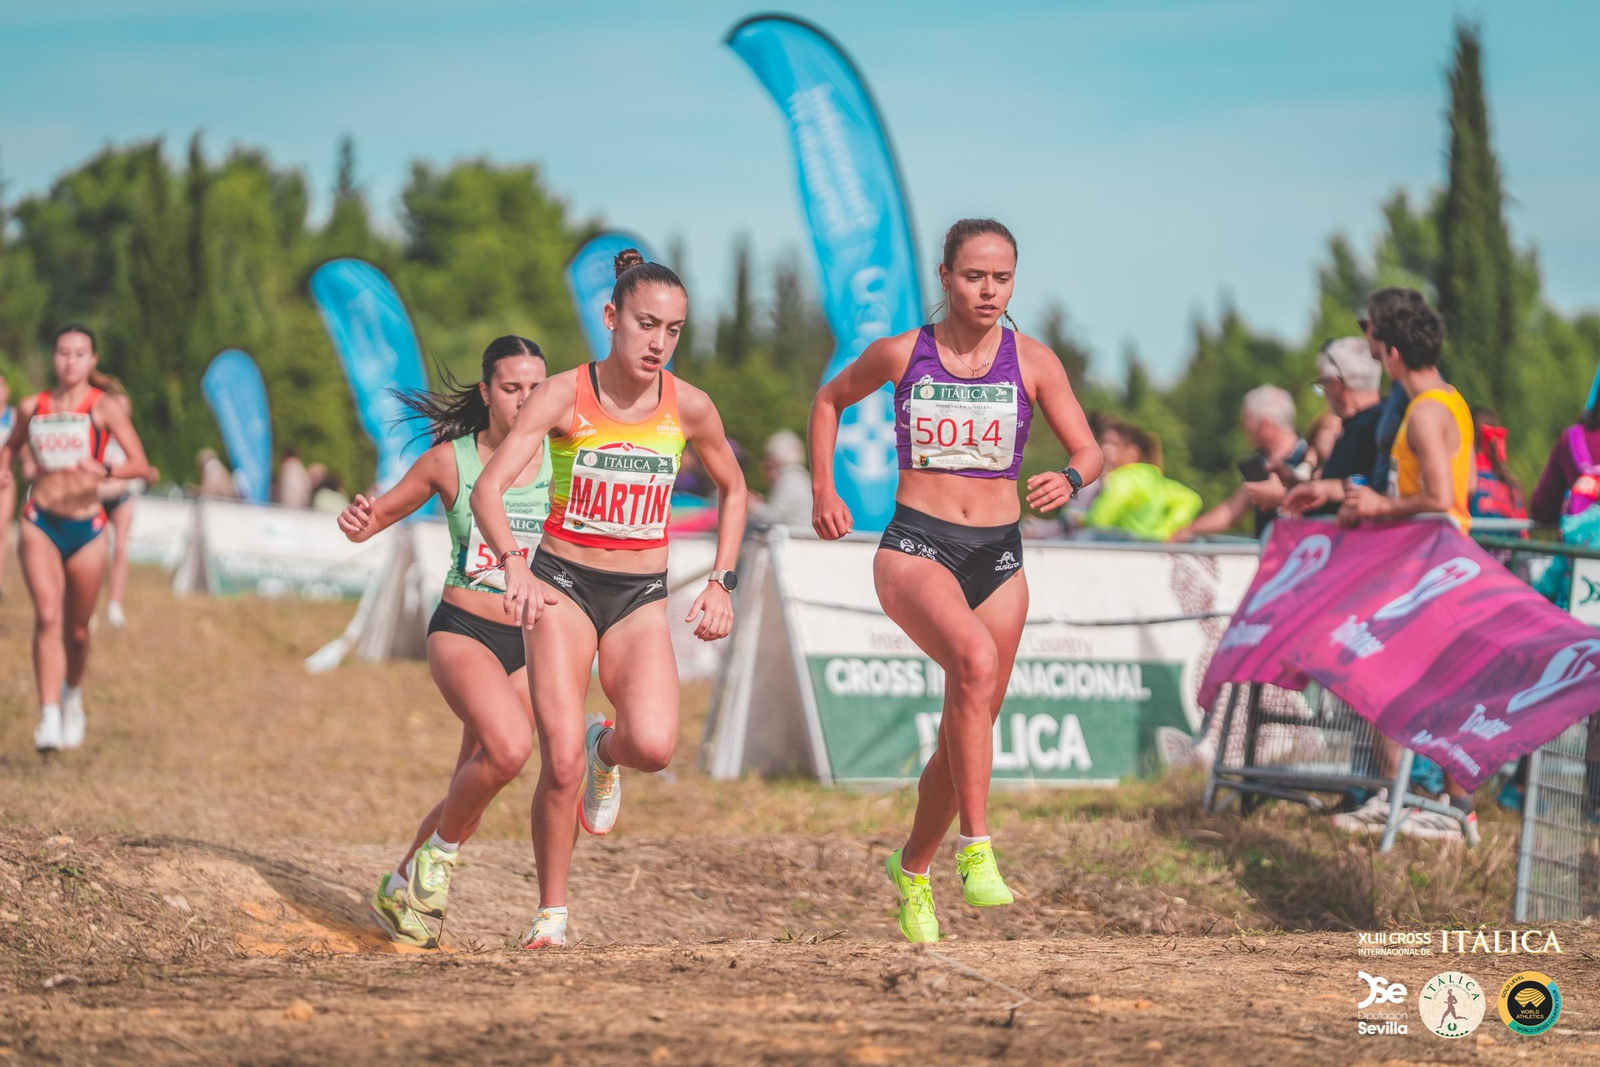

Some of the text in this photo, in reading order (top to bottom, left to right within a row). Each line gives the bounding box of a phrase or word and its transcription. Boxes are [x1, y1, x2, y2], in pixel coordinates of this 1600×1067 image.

[941, 385, 988, 399] ITÁLICA
[916, 417, 1003, 447] 5014
[603, 455, 651, 470] ITÁLICA
[505, 500, 543, 508] Fundación
[568, 474, 671, 526] MARTÍN
[824, 657, 926, 698] CROSS
